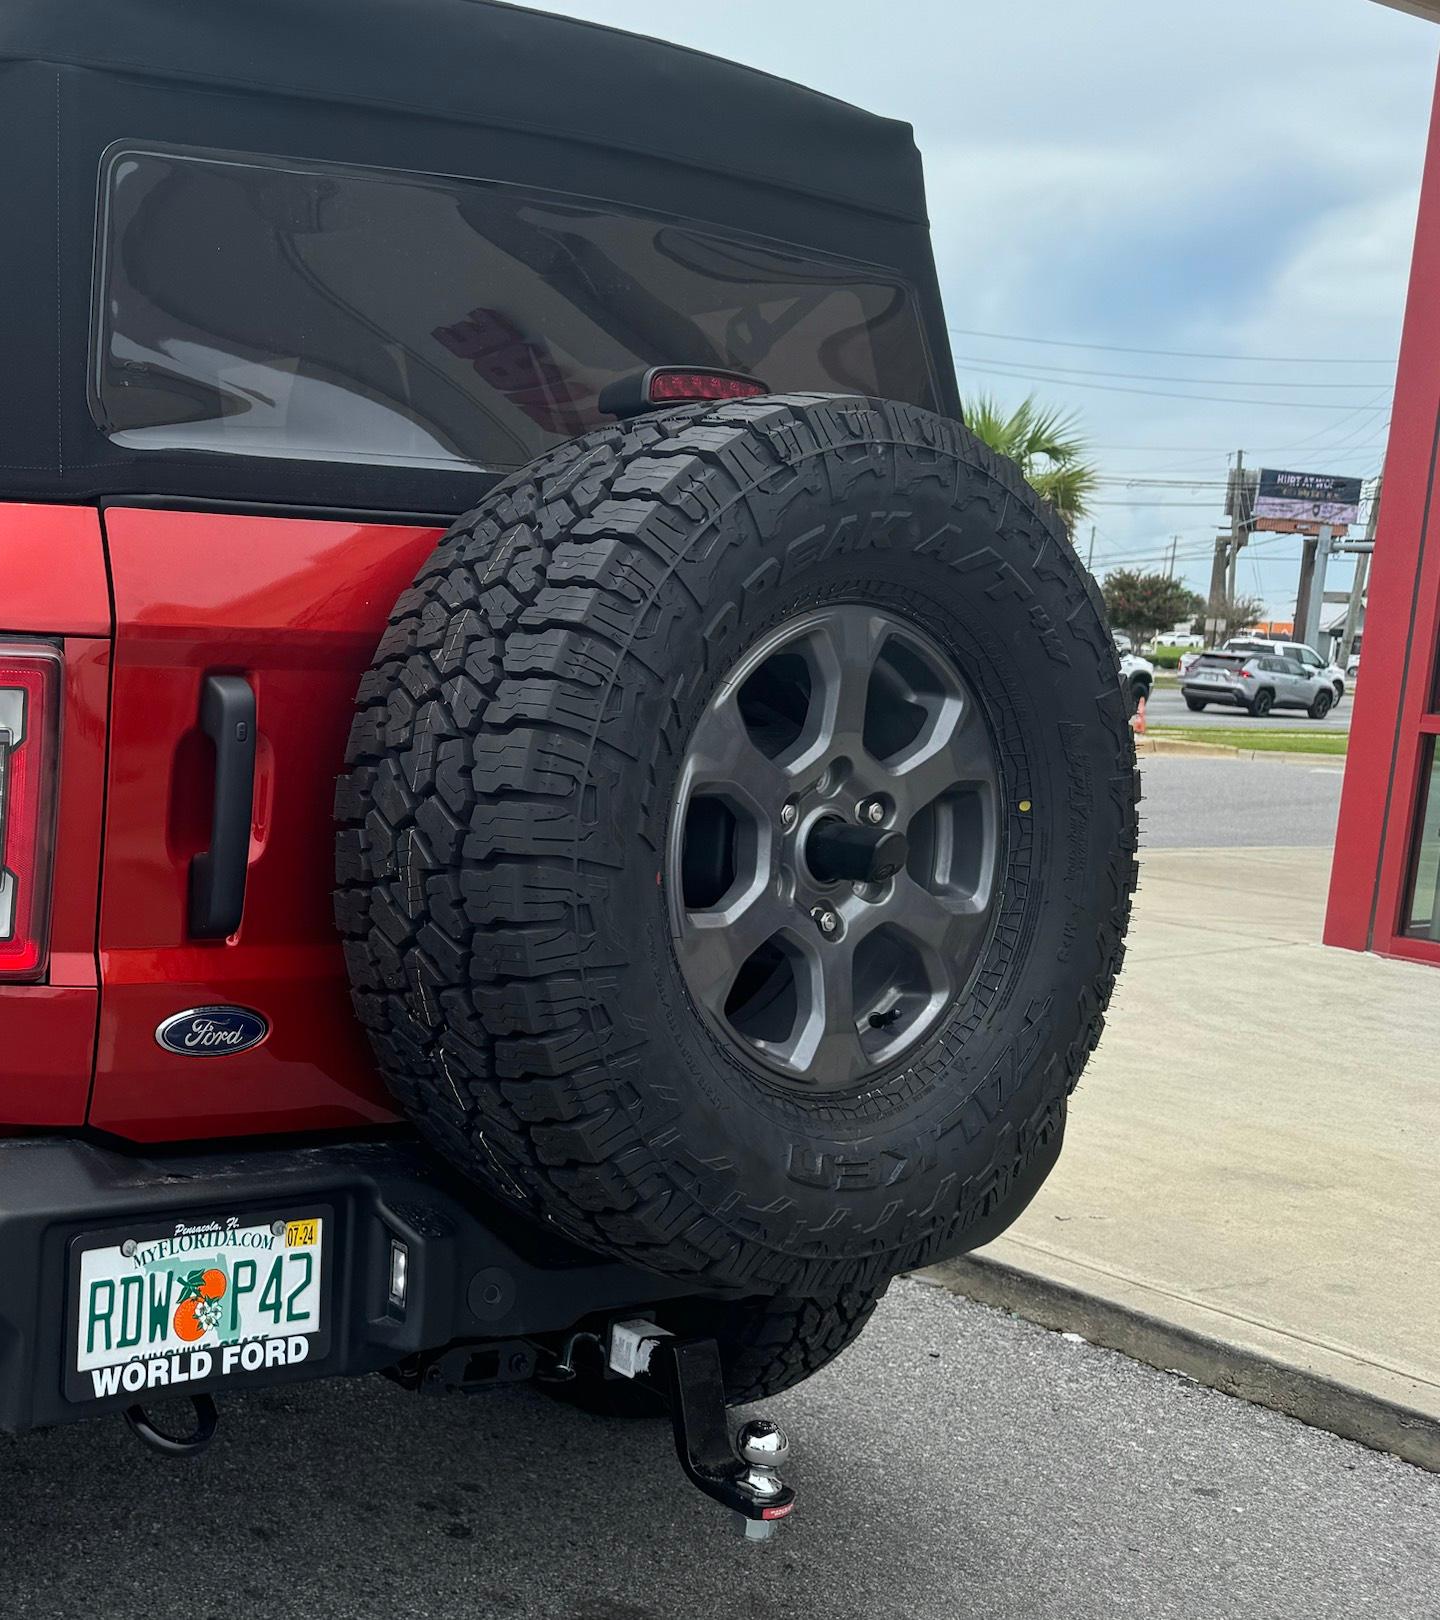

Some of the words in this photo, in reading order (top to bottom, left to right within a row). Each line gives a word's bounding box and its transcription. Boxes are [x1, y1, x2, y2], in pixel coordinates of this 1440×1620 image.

[1276, 473, 1302, 488] HURT
[1302, 476, 1315, 488] AT
[184, 1018, 244, 1047] Ford
[287, 1225, 314, 1247] 07-24
[86, 1270, 174, 1354] RDW
[230, 1252, 314, 1331] P42
[91, 1350, 213, 1399] WORLD
[221, 1335, 310, 1375] FORD
